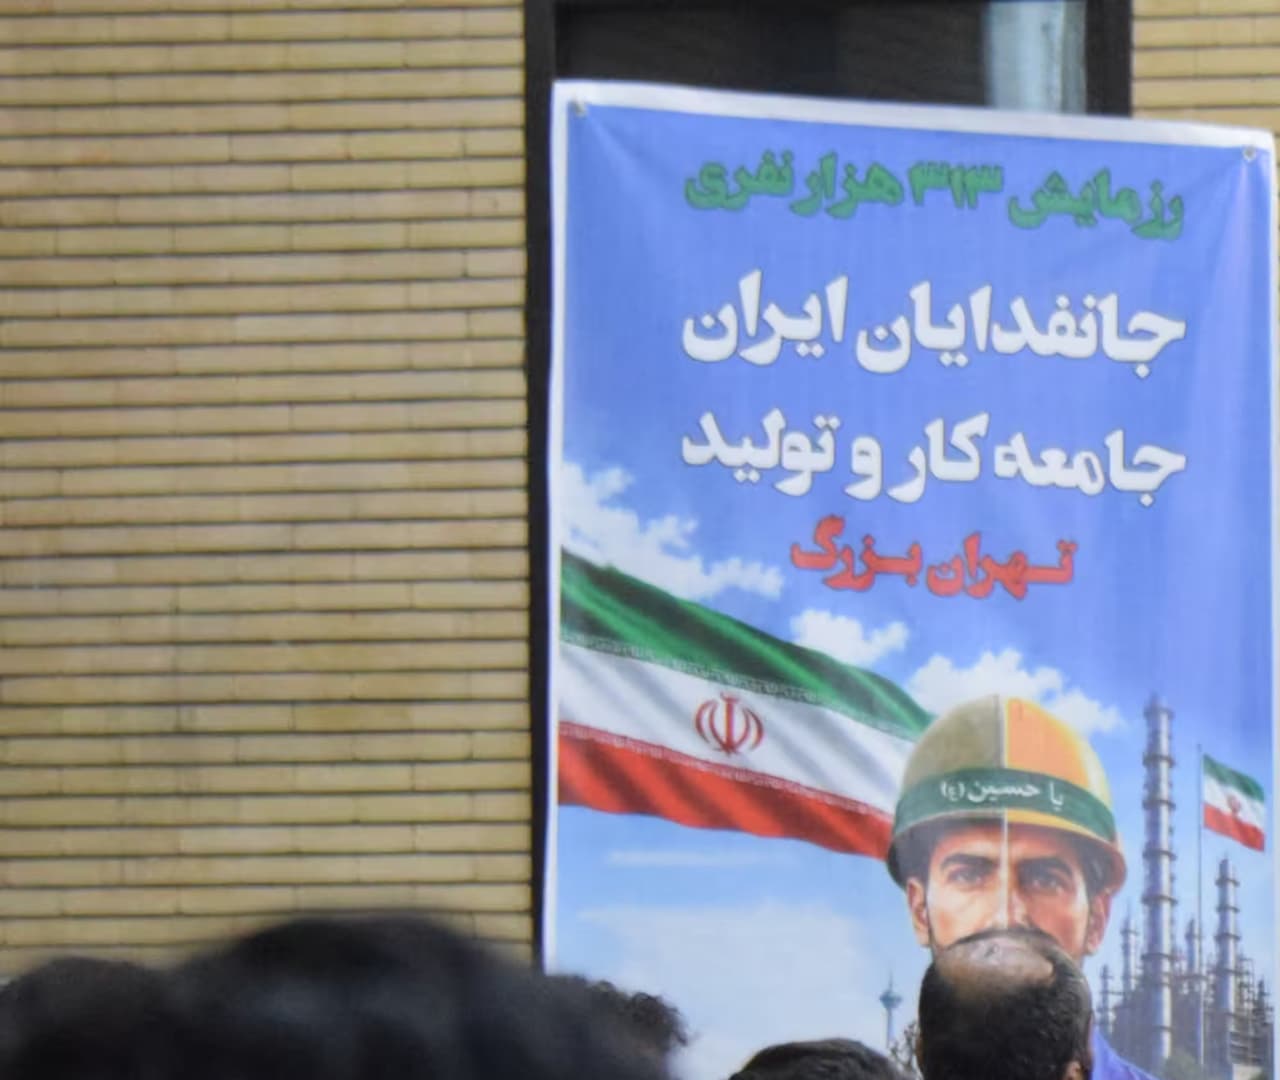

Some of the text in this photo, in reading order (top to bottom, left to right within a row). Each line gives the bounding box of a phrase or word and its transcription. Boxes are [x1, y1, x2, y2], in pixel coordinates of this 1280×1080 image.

[684, 149, 794, 211] نفری
[789, 150, 904, 220] هزار
[682, 268, 1187, 380] جانفدایان ایران
[681, 408, 1187, 507] جامعه کار و تولید
[790, 515, 1078, 600] تهران بزرگ
[967, 781, 1040, 803] حسین
